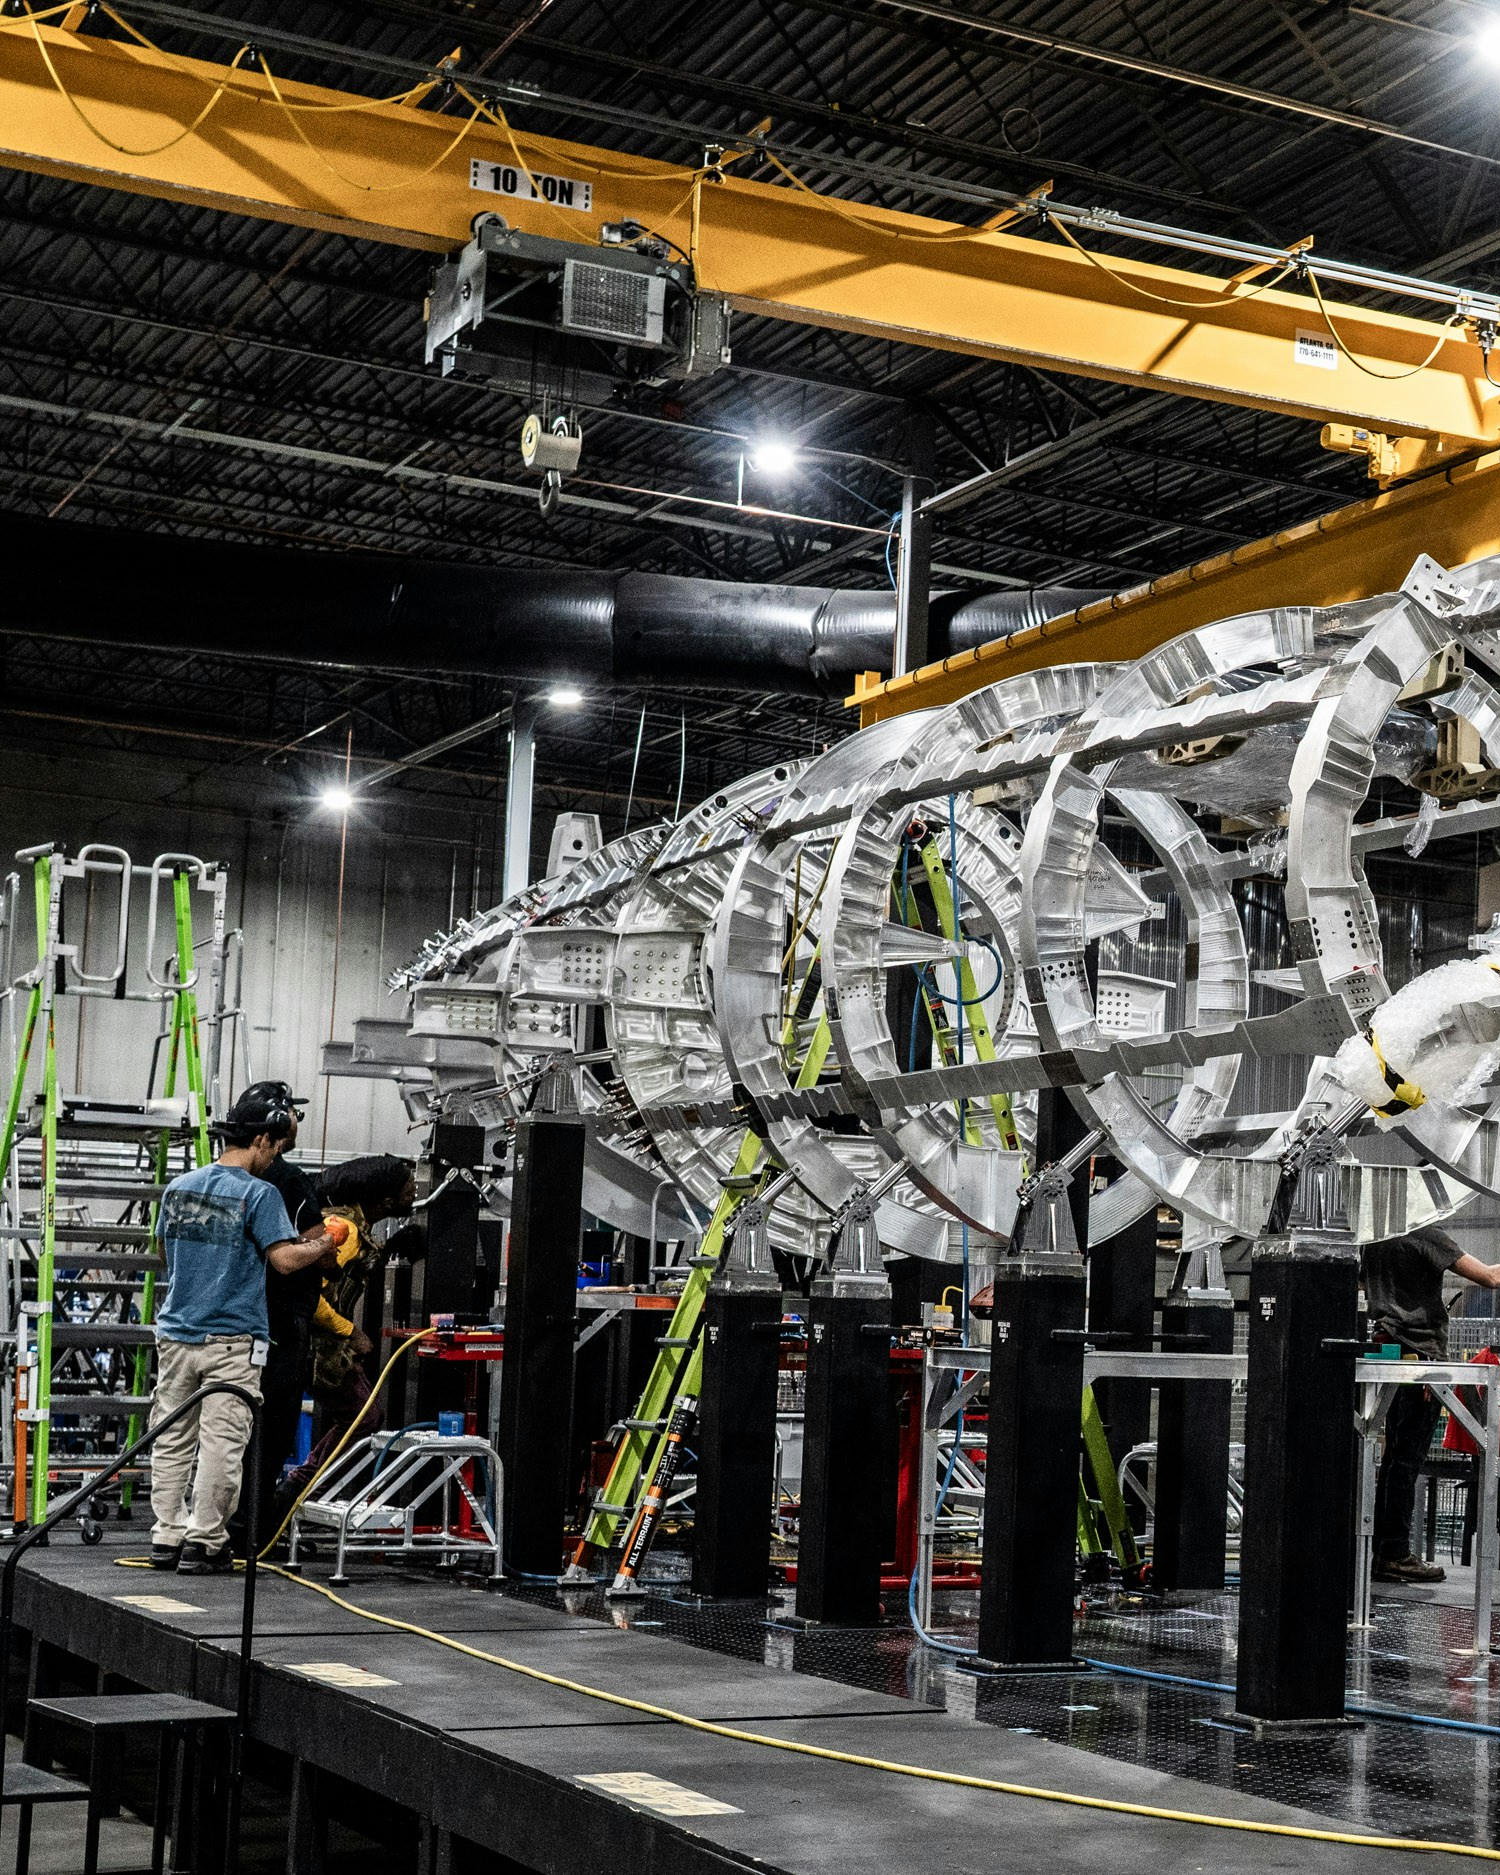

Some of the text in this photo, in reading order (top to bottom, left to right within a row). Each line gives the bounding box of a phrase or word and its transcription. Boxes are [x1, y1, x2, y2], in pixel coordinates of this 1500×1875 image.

[490, 166, 574, 206] 10 TON
[1325, 342, 1334, 350] GA
[629, 1515, 654, 1567] ALL TERRAIN
